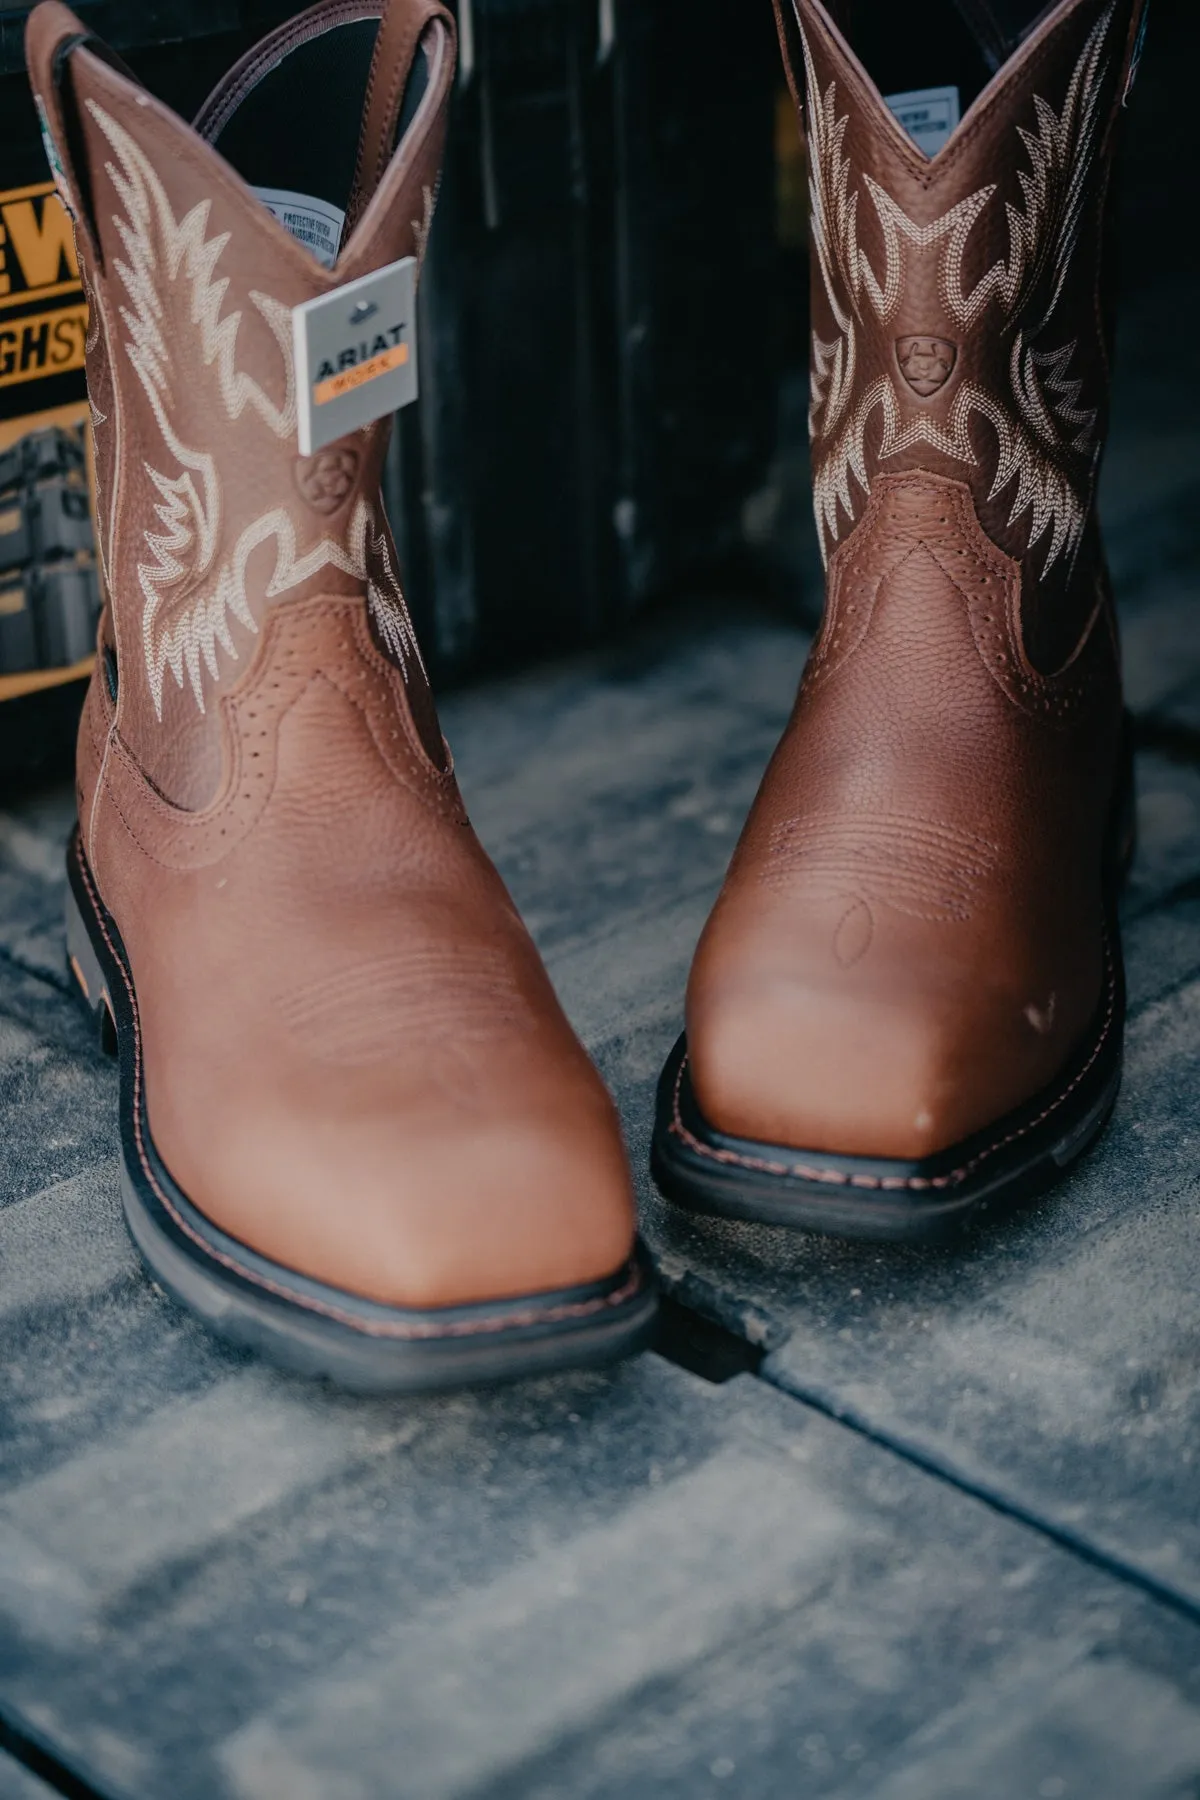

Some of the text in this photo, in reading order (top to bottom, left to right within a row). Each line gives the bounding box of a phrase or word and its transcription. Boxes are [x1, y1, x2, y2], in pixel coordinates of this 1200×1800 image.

[0, 195, 80, 294] W
[283, 212, 316, 230] PROTECTIVE
[315, 322, 407, 383] ARIAT
